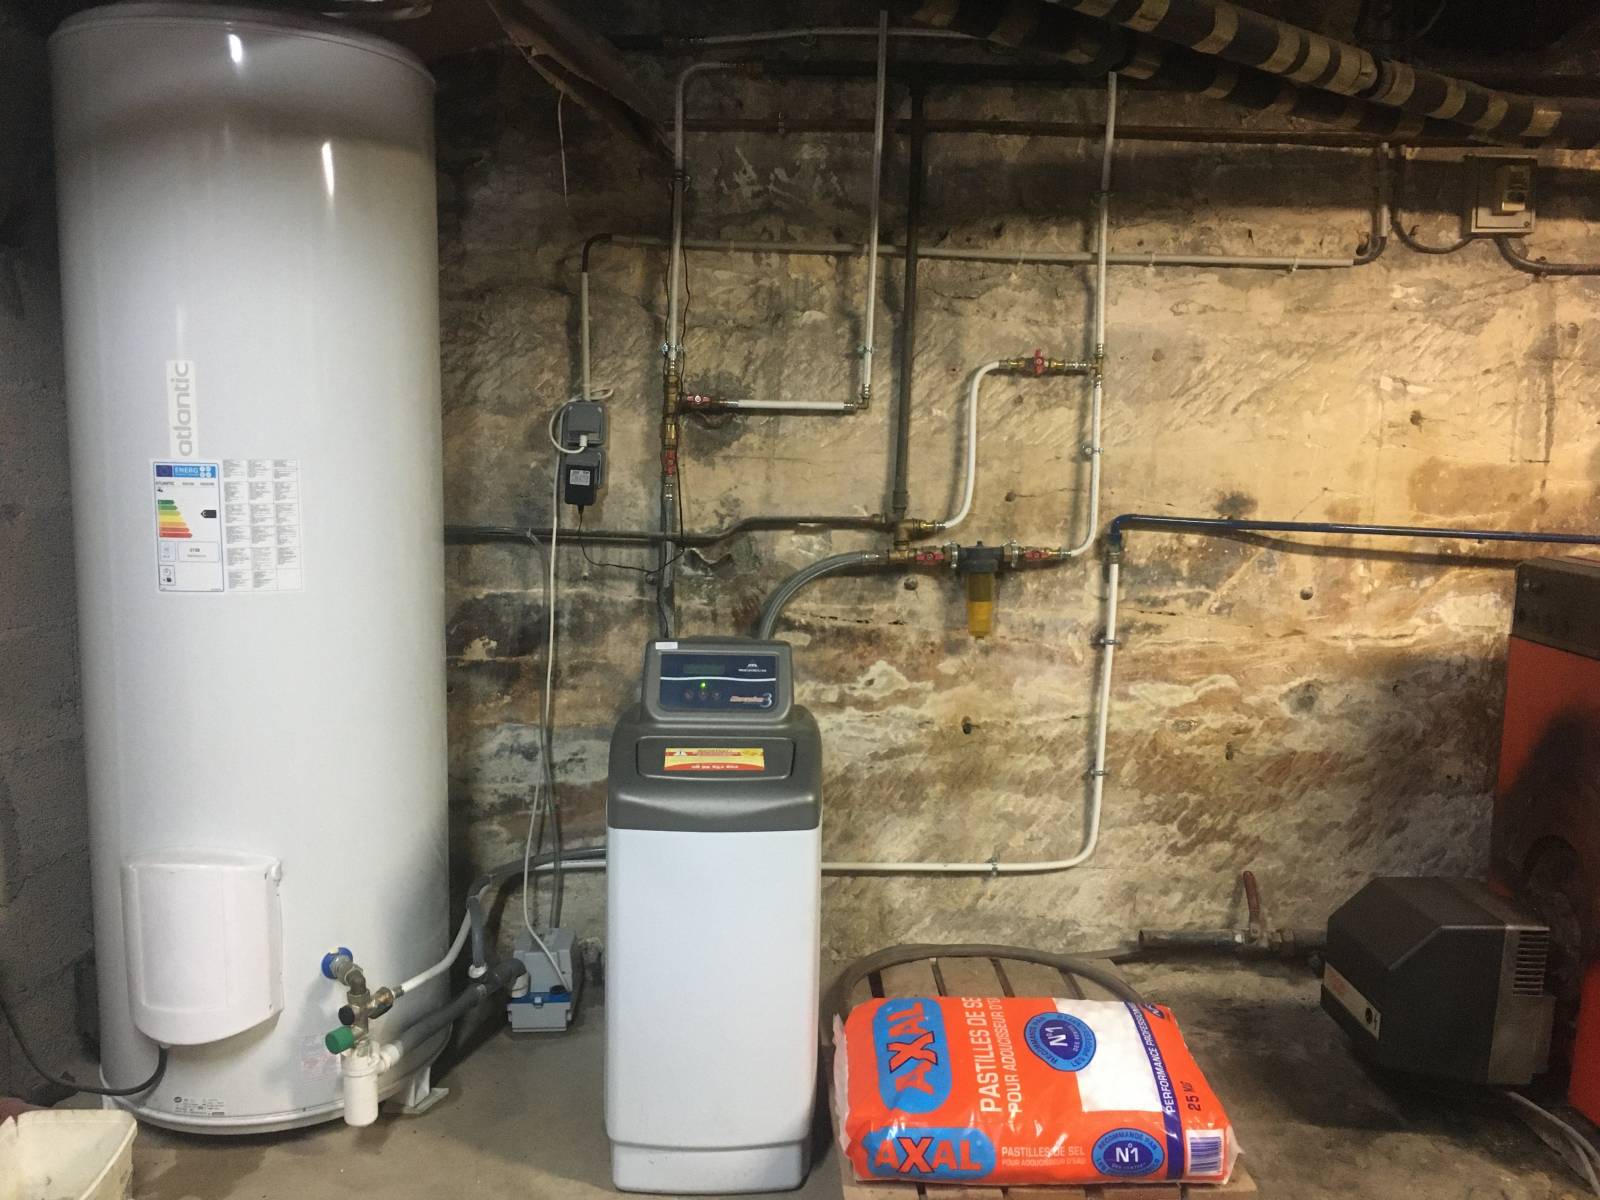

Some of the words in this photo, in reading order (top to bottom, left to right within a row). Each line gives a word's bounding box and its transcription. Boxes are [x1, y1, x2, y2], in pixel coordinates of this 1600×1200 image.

[171, 362, 193, 457] atlantic
[760, 692, 773, 708] 3
[965, 1011, 988, 1027] DE
[886, 1002, 938, 1095] AXAL
[968, 1029, 1003, 1113] PASTILLES
[1148, 1046, 1176, 1114] PERFORMANCE
[1004, 1074, 1023, 1113] POUR
[1185, 1095, 1202, 1112] 25
[875, 1136, 982, 1174] AXAL
[1002, 1146, 1050, 1157] PASTILLES
[1068, 1145, 1086, 1157] SEL
